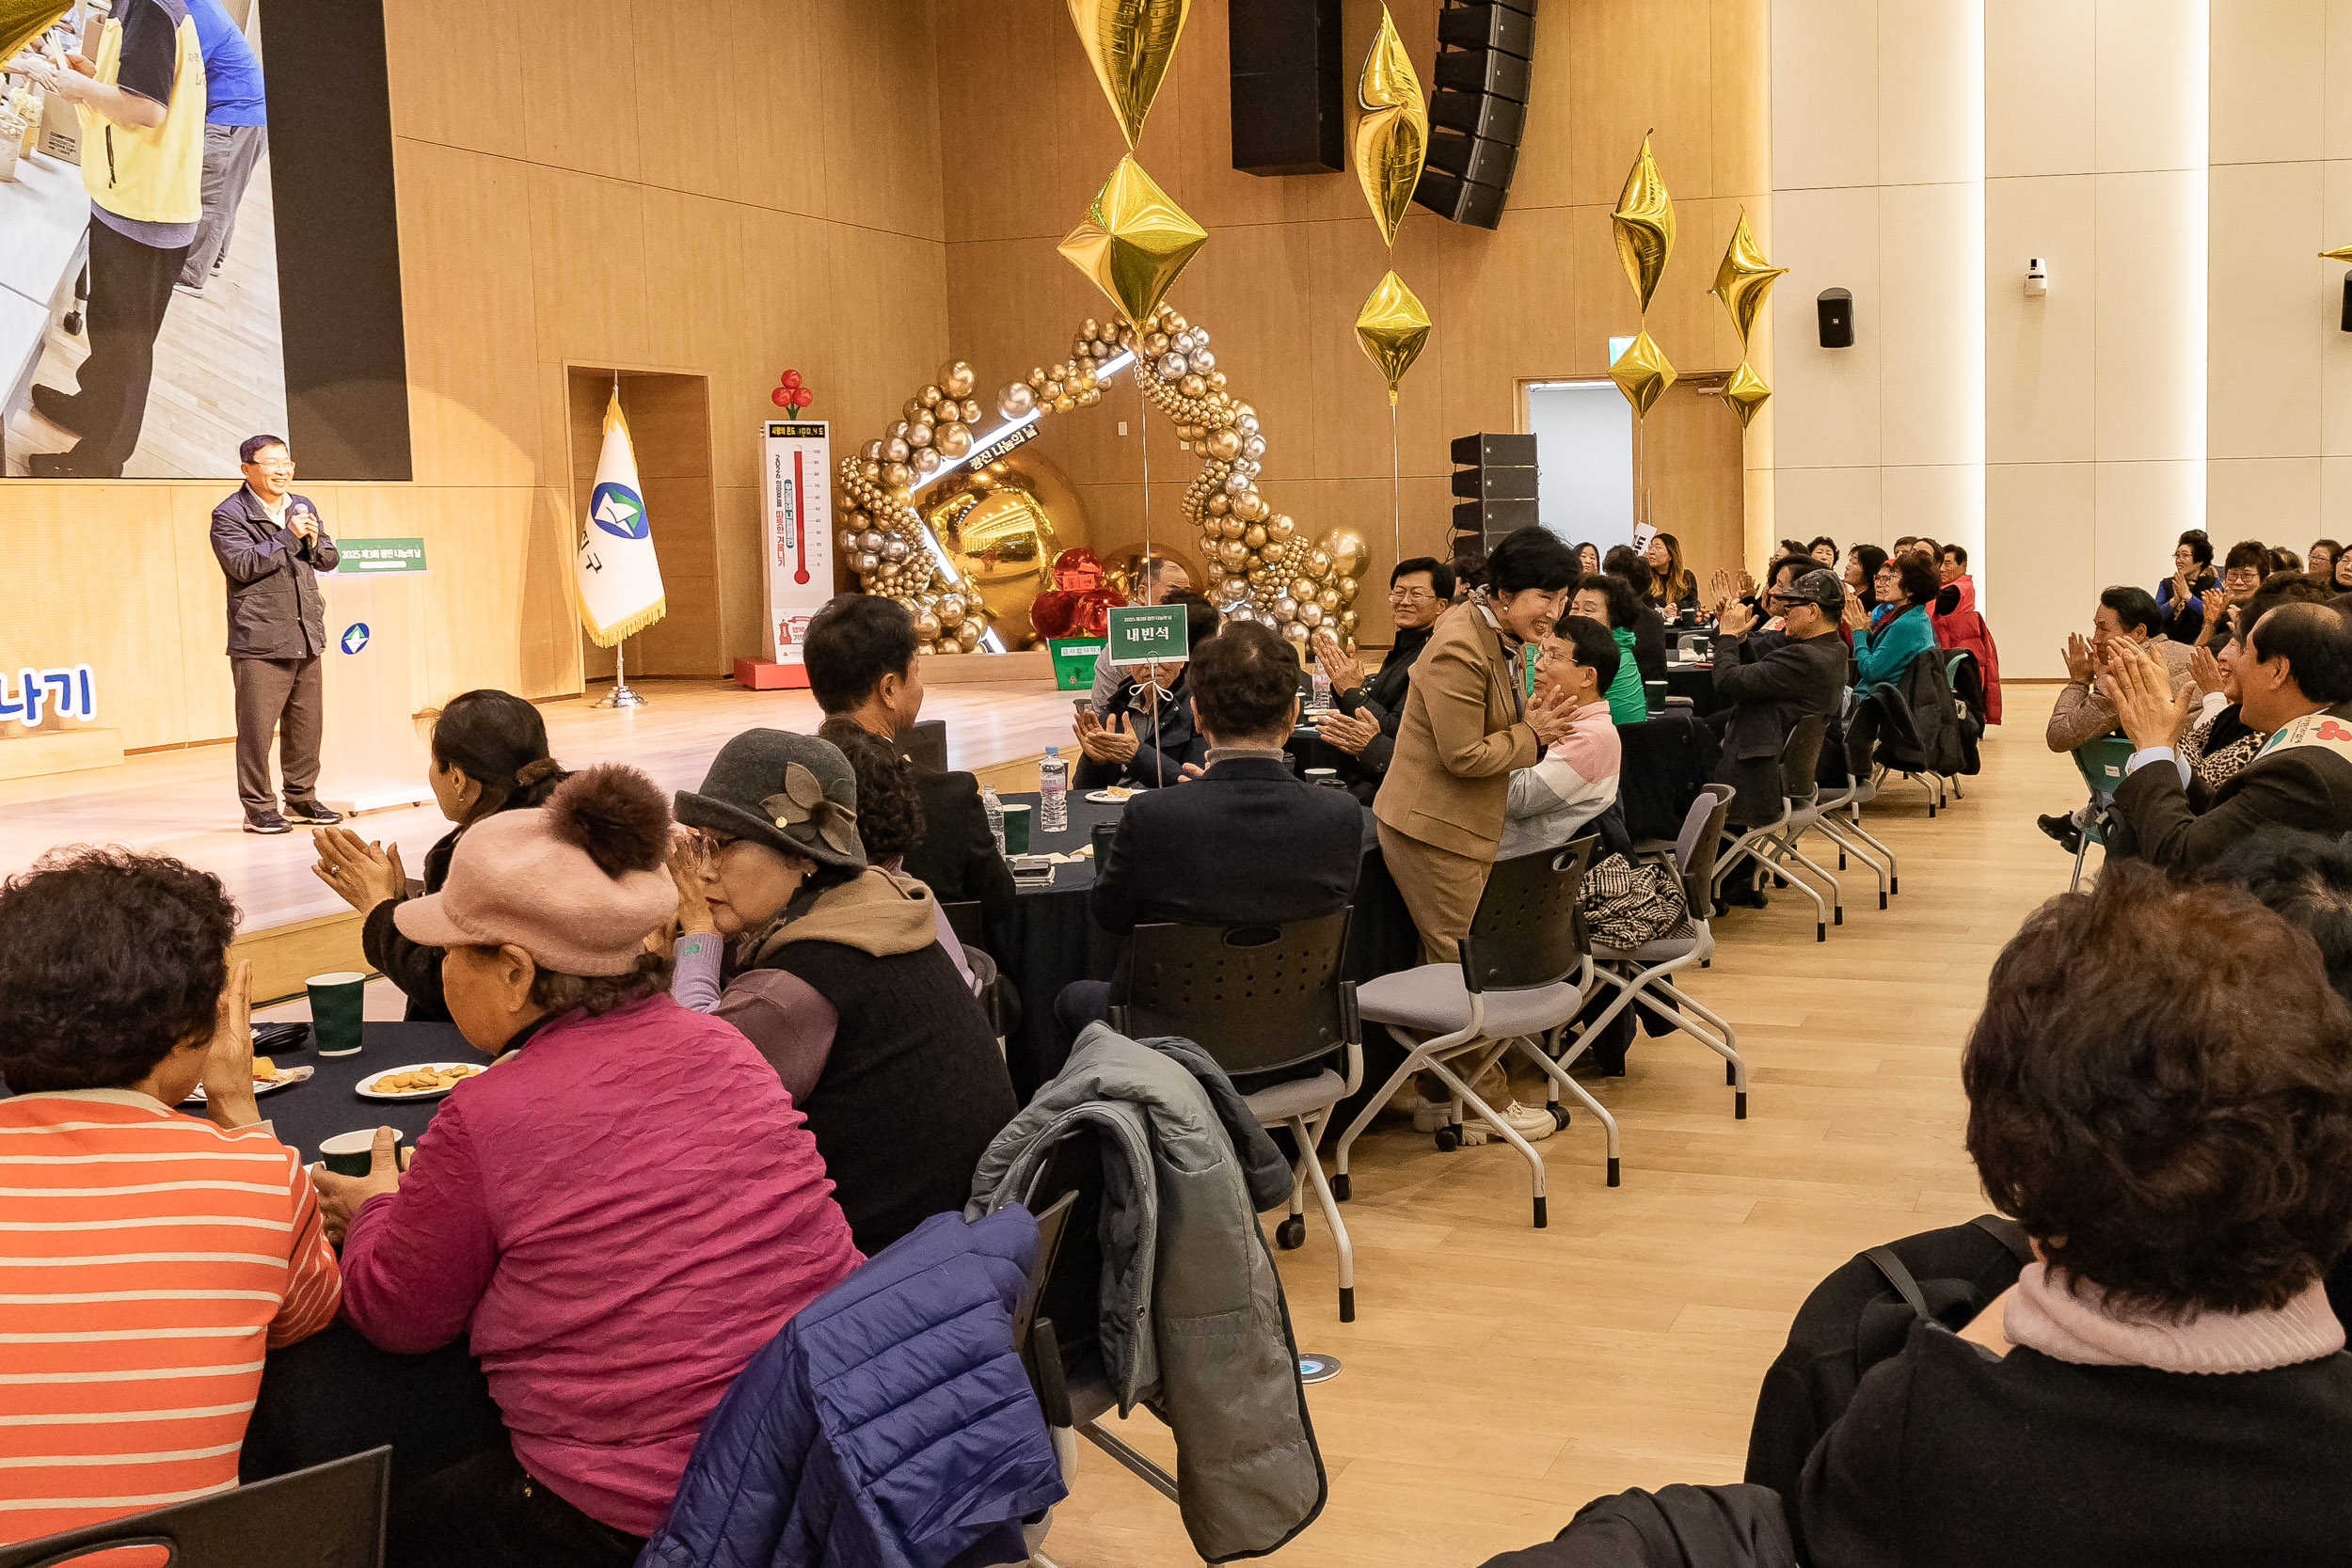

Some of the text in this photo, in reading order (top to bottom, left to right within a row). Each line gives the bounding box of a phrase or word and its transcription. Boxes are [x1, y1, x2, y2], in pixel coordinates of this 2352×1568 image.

[969, 423, 1038, 470] 광진 나눔의 날
[342, 549, 361, 560] 2025
[777, 535, 786, 567] 겨울나기
[1126, 626, 1169, 642] 내빈석
[0, 668, 92, 721] 나기
